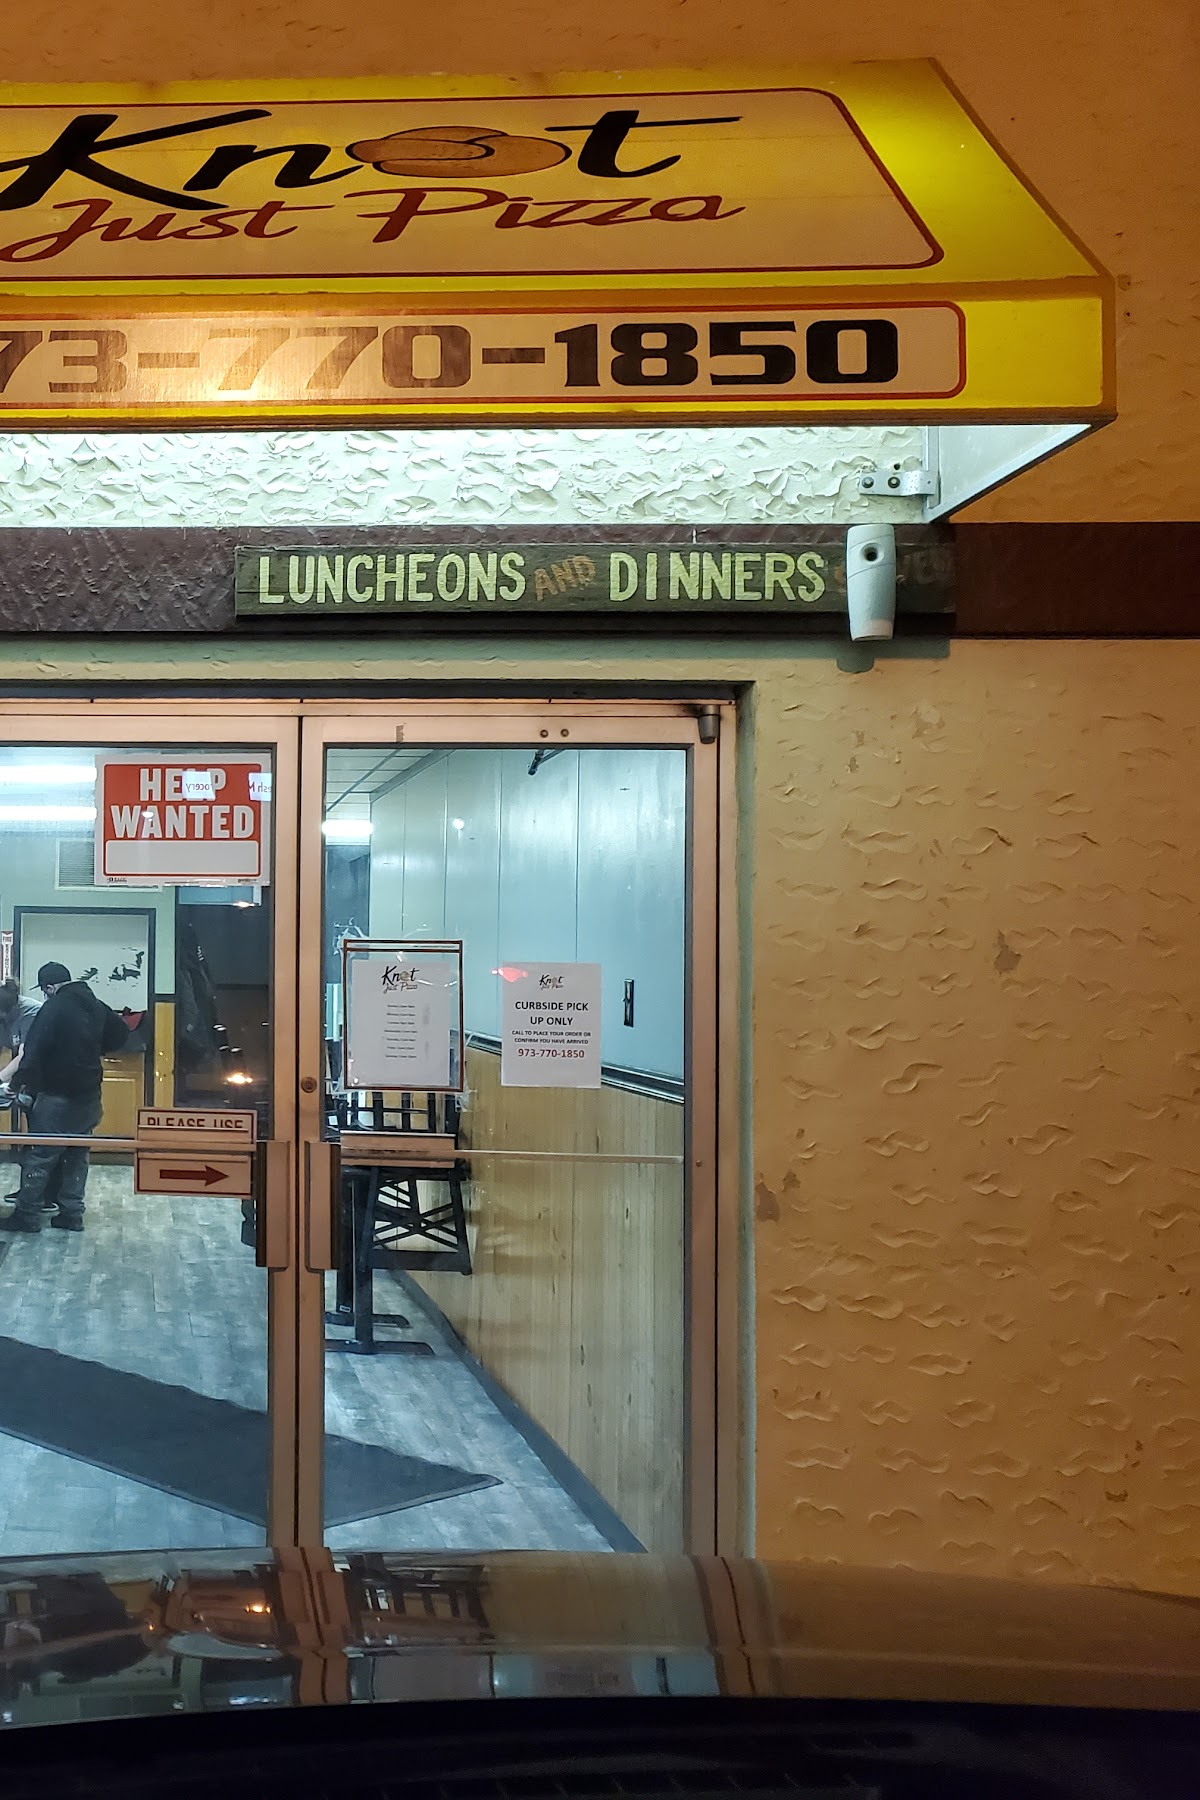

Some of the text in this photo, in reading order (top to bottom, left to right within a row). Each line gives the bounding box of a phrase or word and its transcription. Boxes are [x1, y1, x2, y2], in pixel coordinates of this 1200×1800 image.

[343, 186, 746, 243] Pizza
[258, 551, 527, 604] LUNCHEONS
[533, 555, 597, 602] AND
[609, 551, 827, 603] DINNERS
[139, 767, 227, 802] HEP
[110, 804, 255, 839] WANTED
[515, 1001, 589, 1011] CURBSIDE PICK
[530, 1016, 573, 1026] UP ONLY
[518, 1048, 585, 1059] 973-770-1850
